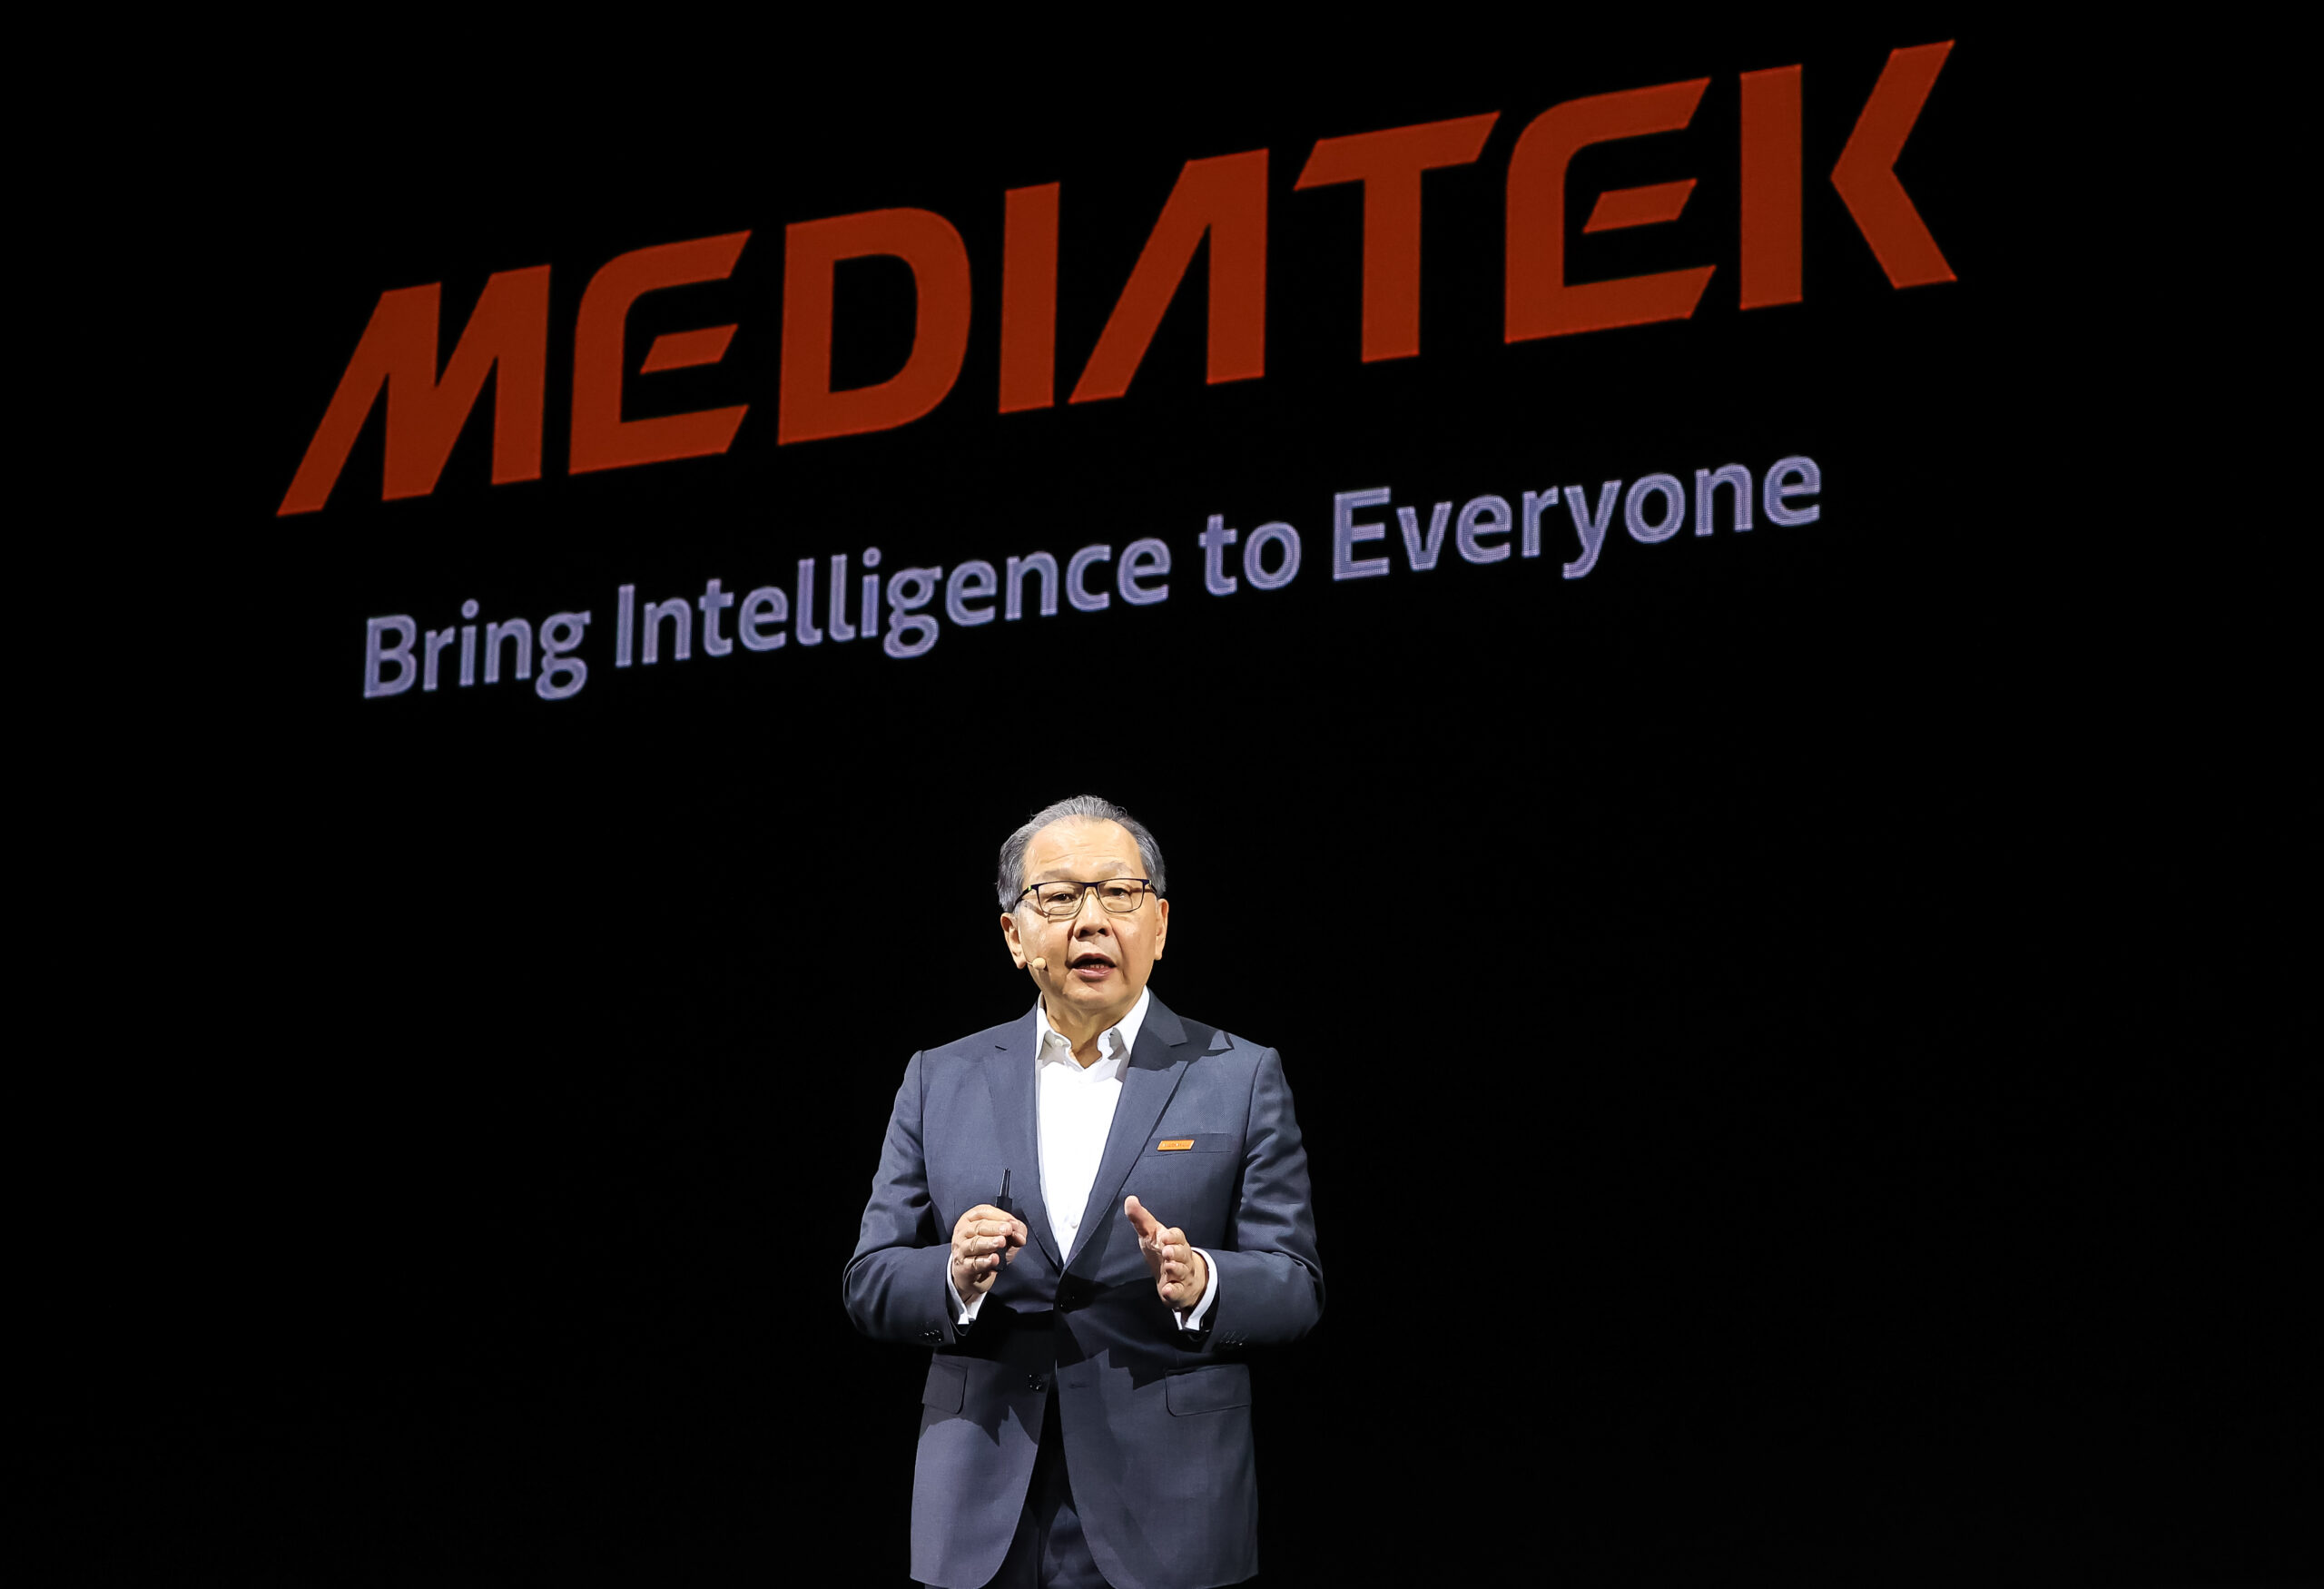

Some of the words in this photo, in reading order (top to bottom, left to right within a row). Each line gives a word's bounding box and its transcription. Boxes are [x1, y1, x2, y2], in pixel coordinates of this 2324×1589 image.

[277, 40, 1957, 517] MEDIATEK
[363, 599, 590, 700] Bring
[615, 538, 1171, 668] Intelligence
[1198, 514, 1301, 596] to
[1333, 456, 1821, 581] Everyone
